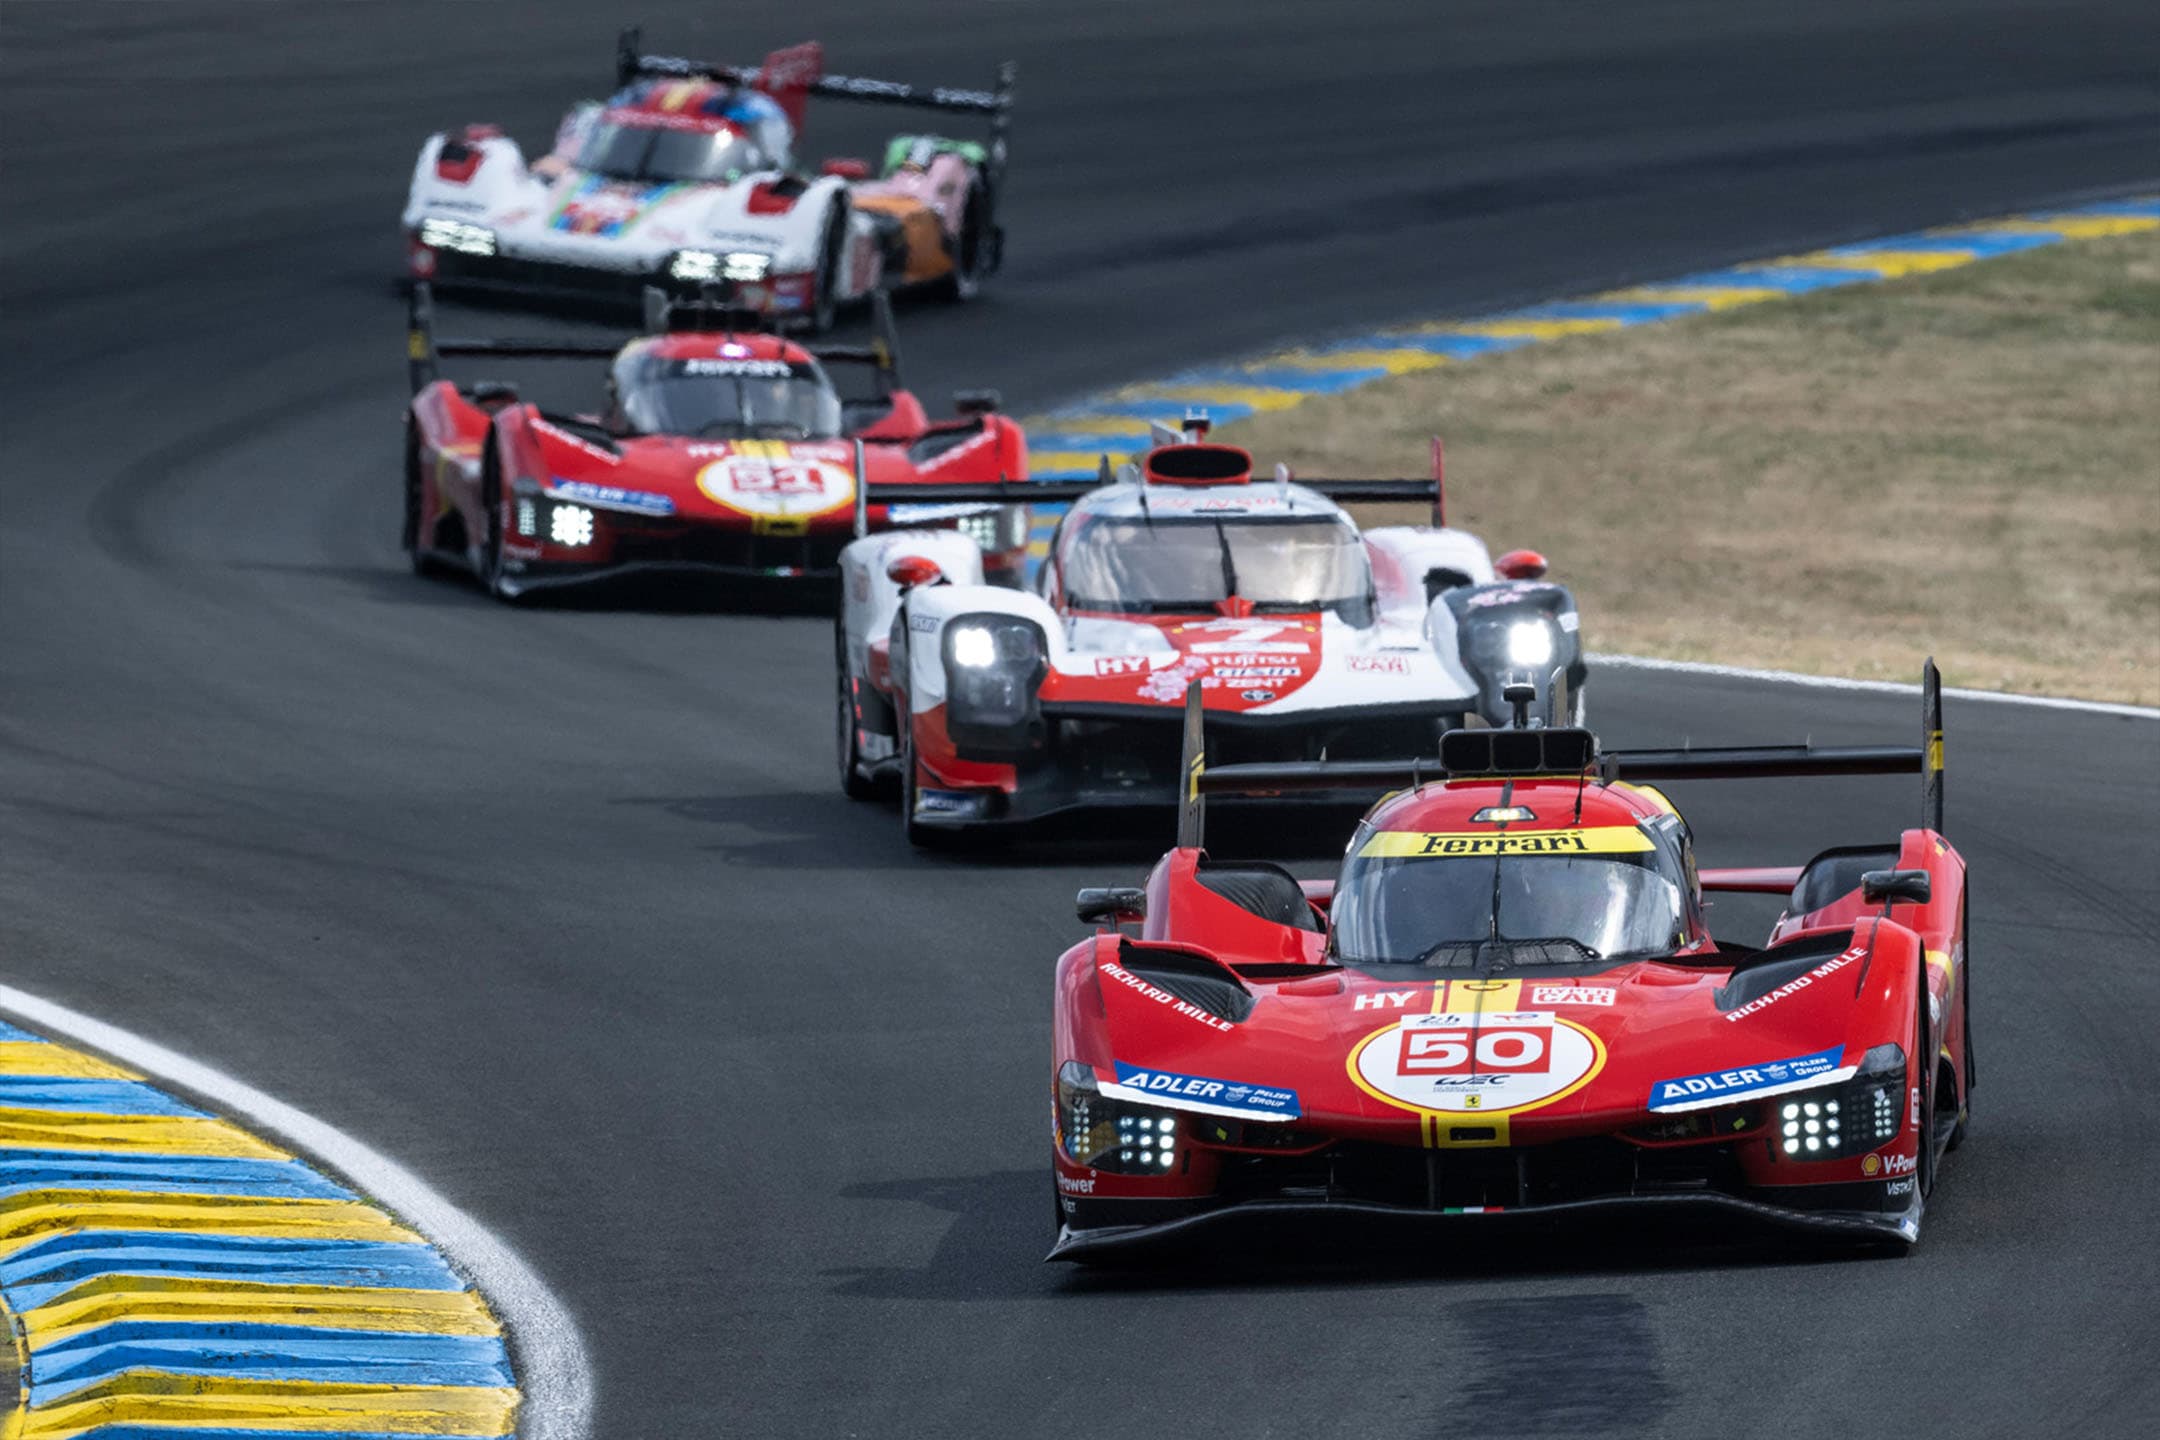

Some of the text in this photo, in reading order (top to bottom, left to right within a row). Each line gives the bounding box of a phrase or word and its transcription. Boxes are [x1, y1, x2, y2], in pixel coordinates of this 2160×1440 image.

[1099, 657, 1147, 675] HY
[1417, 830, 1589, 854] Ferrari
[1726, 946, 1868, 1023] RICHARD MILLE
[1099, 962, 1234, 1033] RICHARD MILLE
[1353, 990, 1419, 1011] HY
[1405, 1030, 1544, 1071] 50
[1433, 1074, 1511, 1086] WEC
[1795, 1063, 1833, 1076] GROUP
[1119, 1072, 1226, 1098] ADLER
[1663, 1067, 1766, 1099] ADLER
[1247, 1095, 1286, 1108] GROUP
